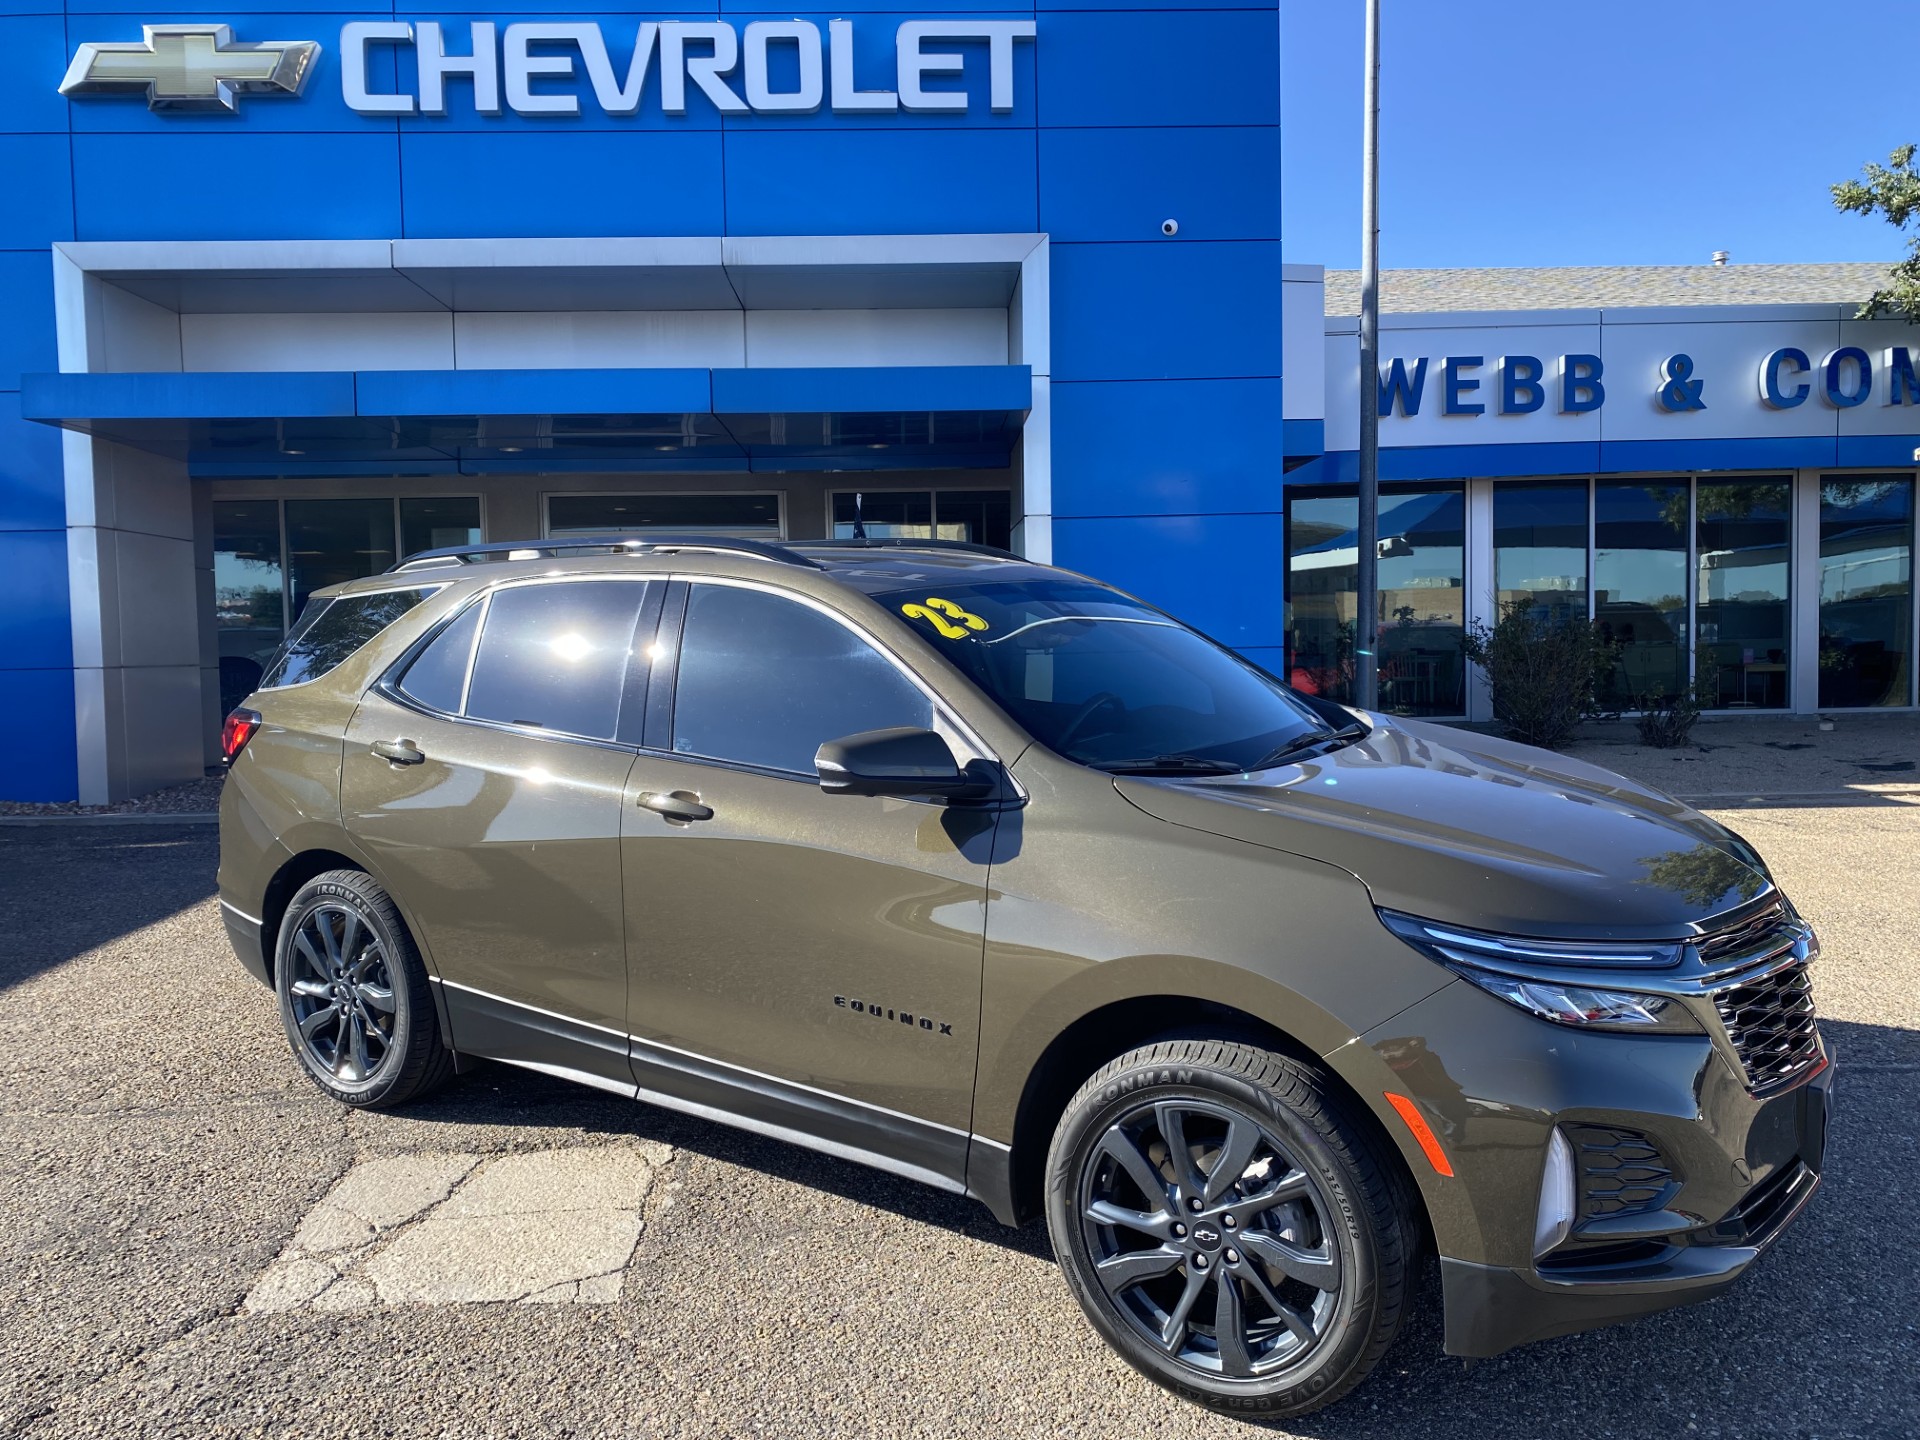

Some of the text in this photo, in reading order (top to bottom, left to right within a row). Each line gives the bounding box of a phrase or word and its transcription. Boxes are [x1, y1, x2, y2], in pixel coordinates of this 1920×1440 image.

[340, 19, 1037, 115] CHEVROLET
[1378, 354, 1605, 417] WEBB
[1655, 353, 1707, 413] &
[901, 597, 989, 640] 23
[317, 885, 370, 914] IRONMAN
[833, 994, 953, 1036] EQUINOX
[1321, 1167, 1360, 1240] 235/50R19
